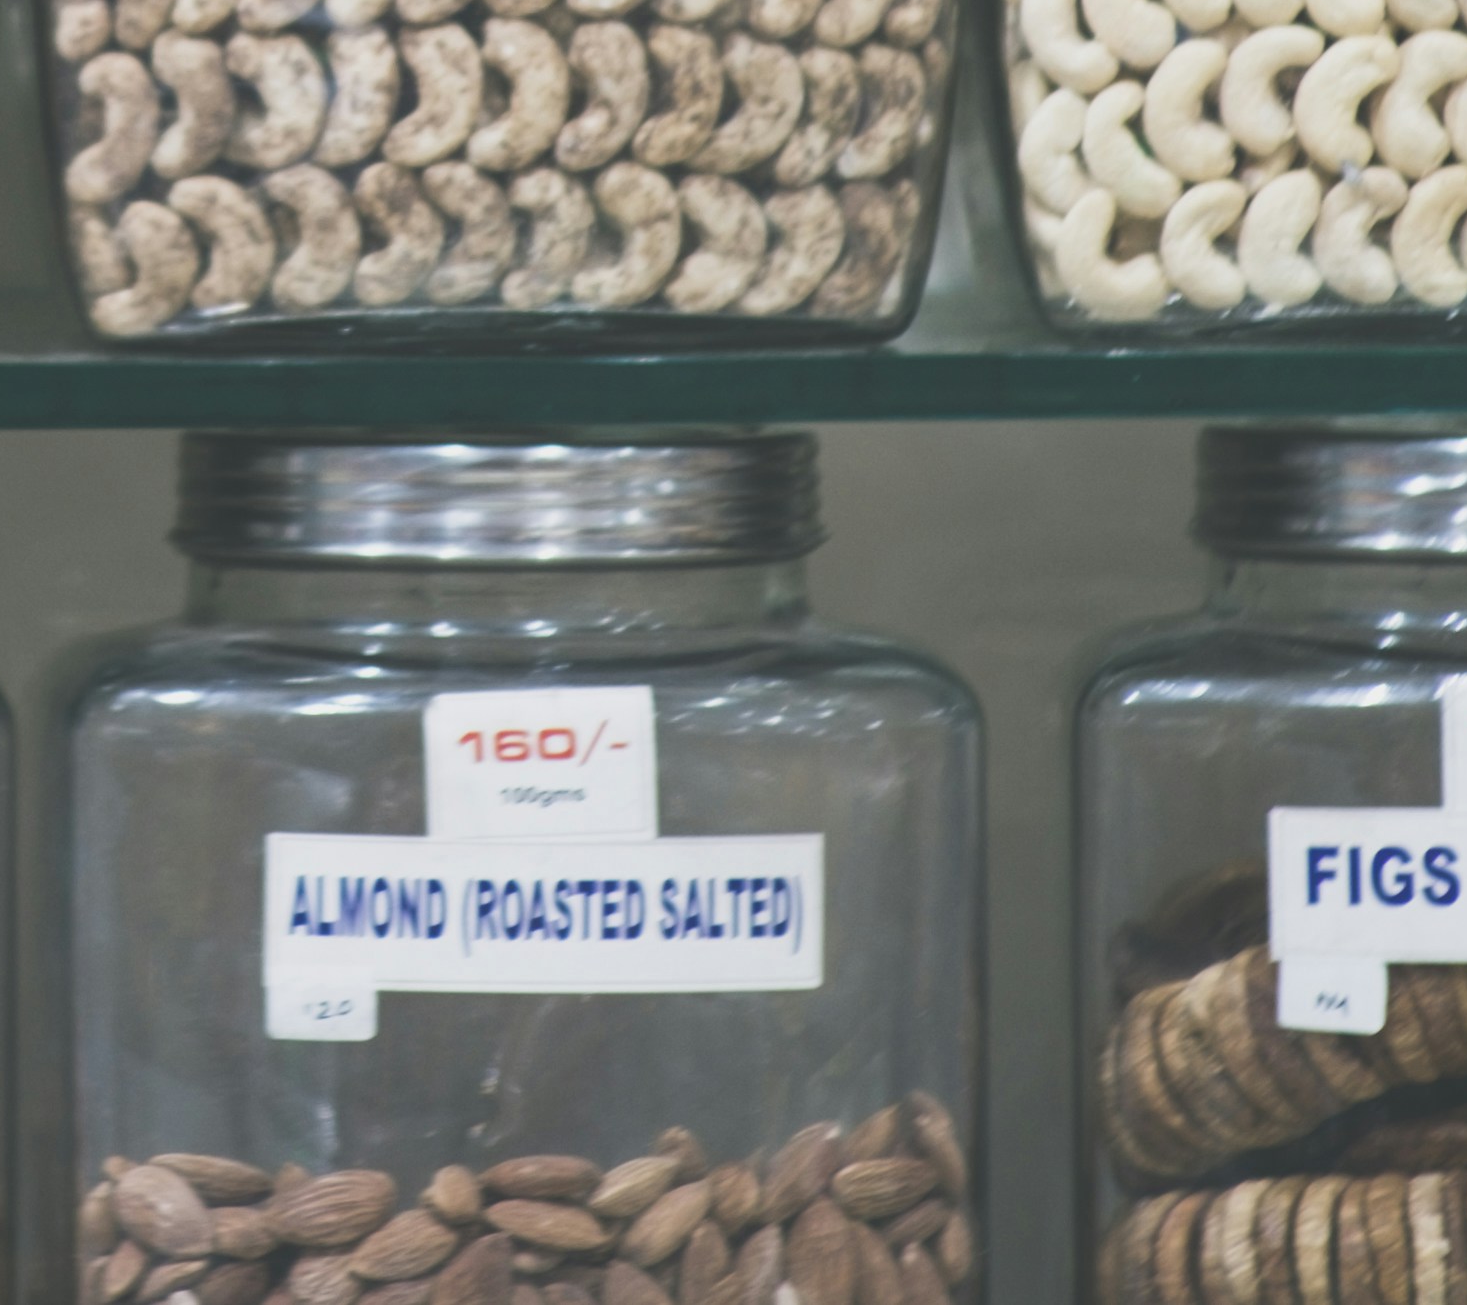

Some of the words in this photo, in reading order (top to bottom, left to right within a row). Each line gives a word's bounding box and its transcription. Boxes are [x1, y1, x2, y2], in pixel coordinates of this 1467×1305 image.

[456, 725, 630, 766] 160/-
[499, 786, 587, 808] 100gms
[1306, 845, 1461, 907] FIGS
[289, 875, 446, 940] ALMOND
[459, 873, 648, 958] (ROASTED
[658, 873, 805, 955] SALTED)
